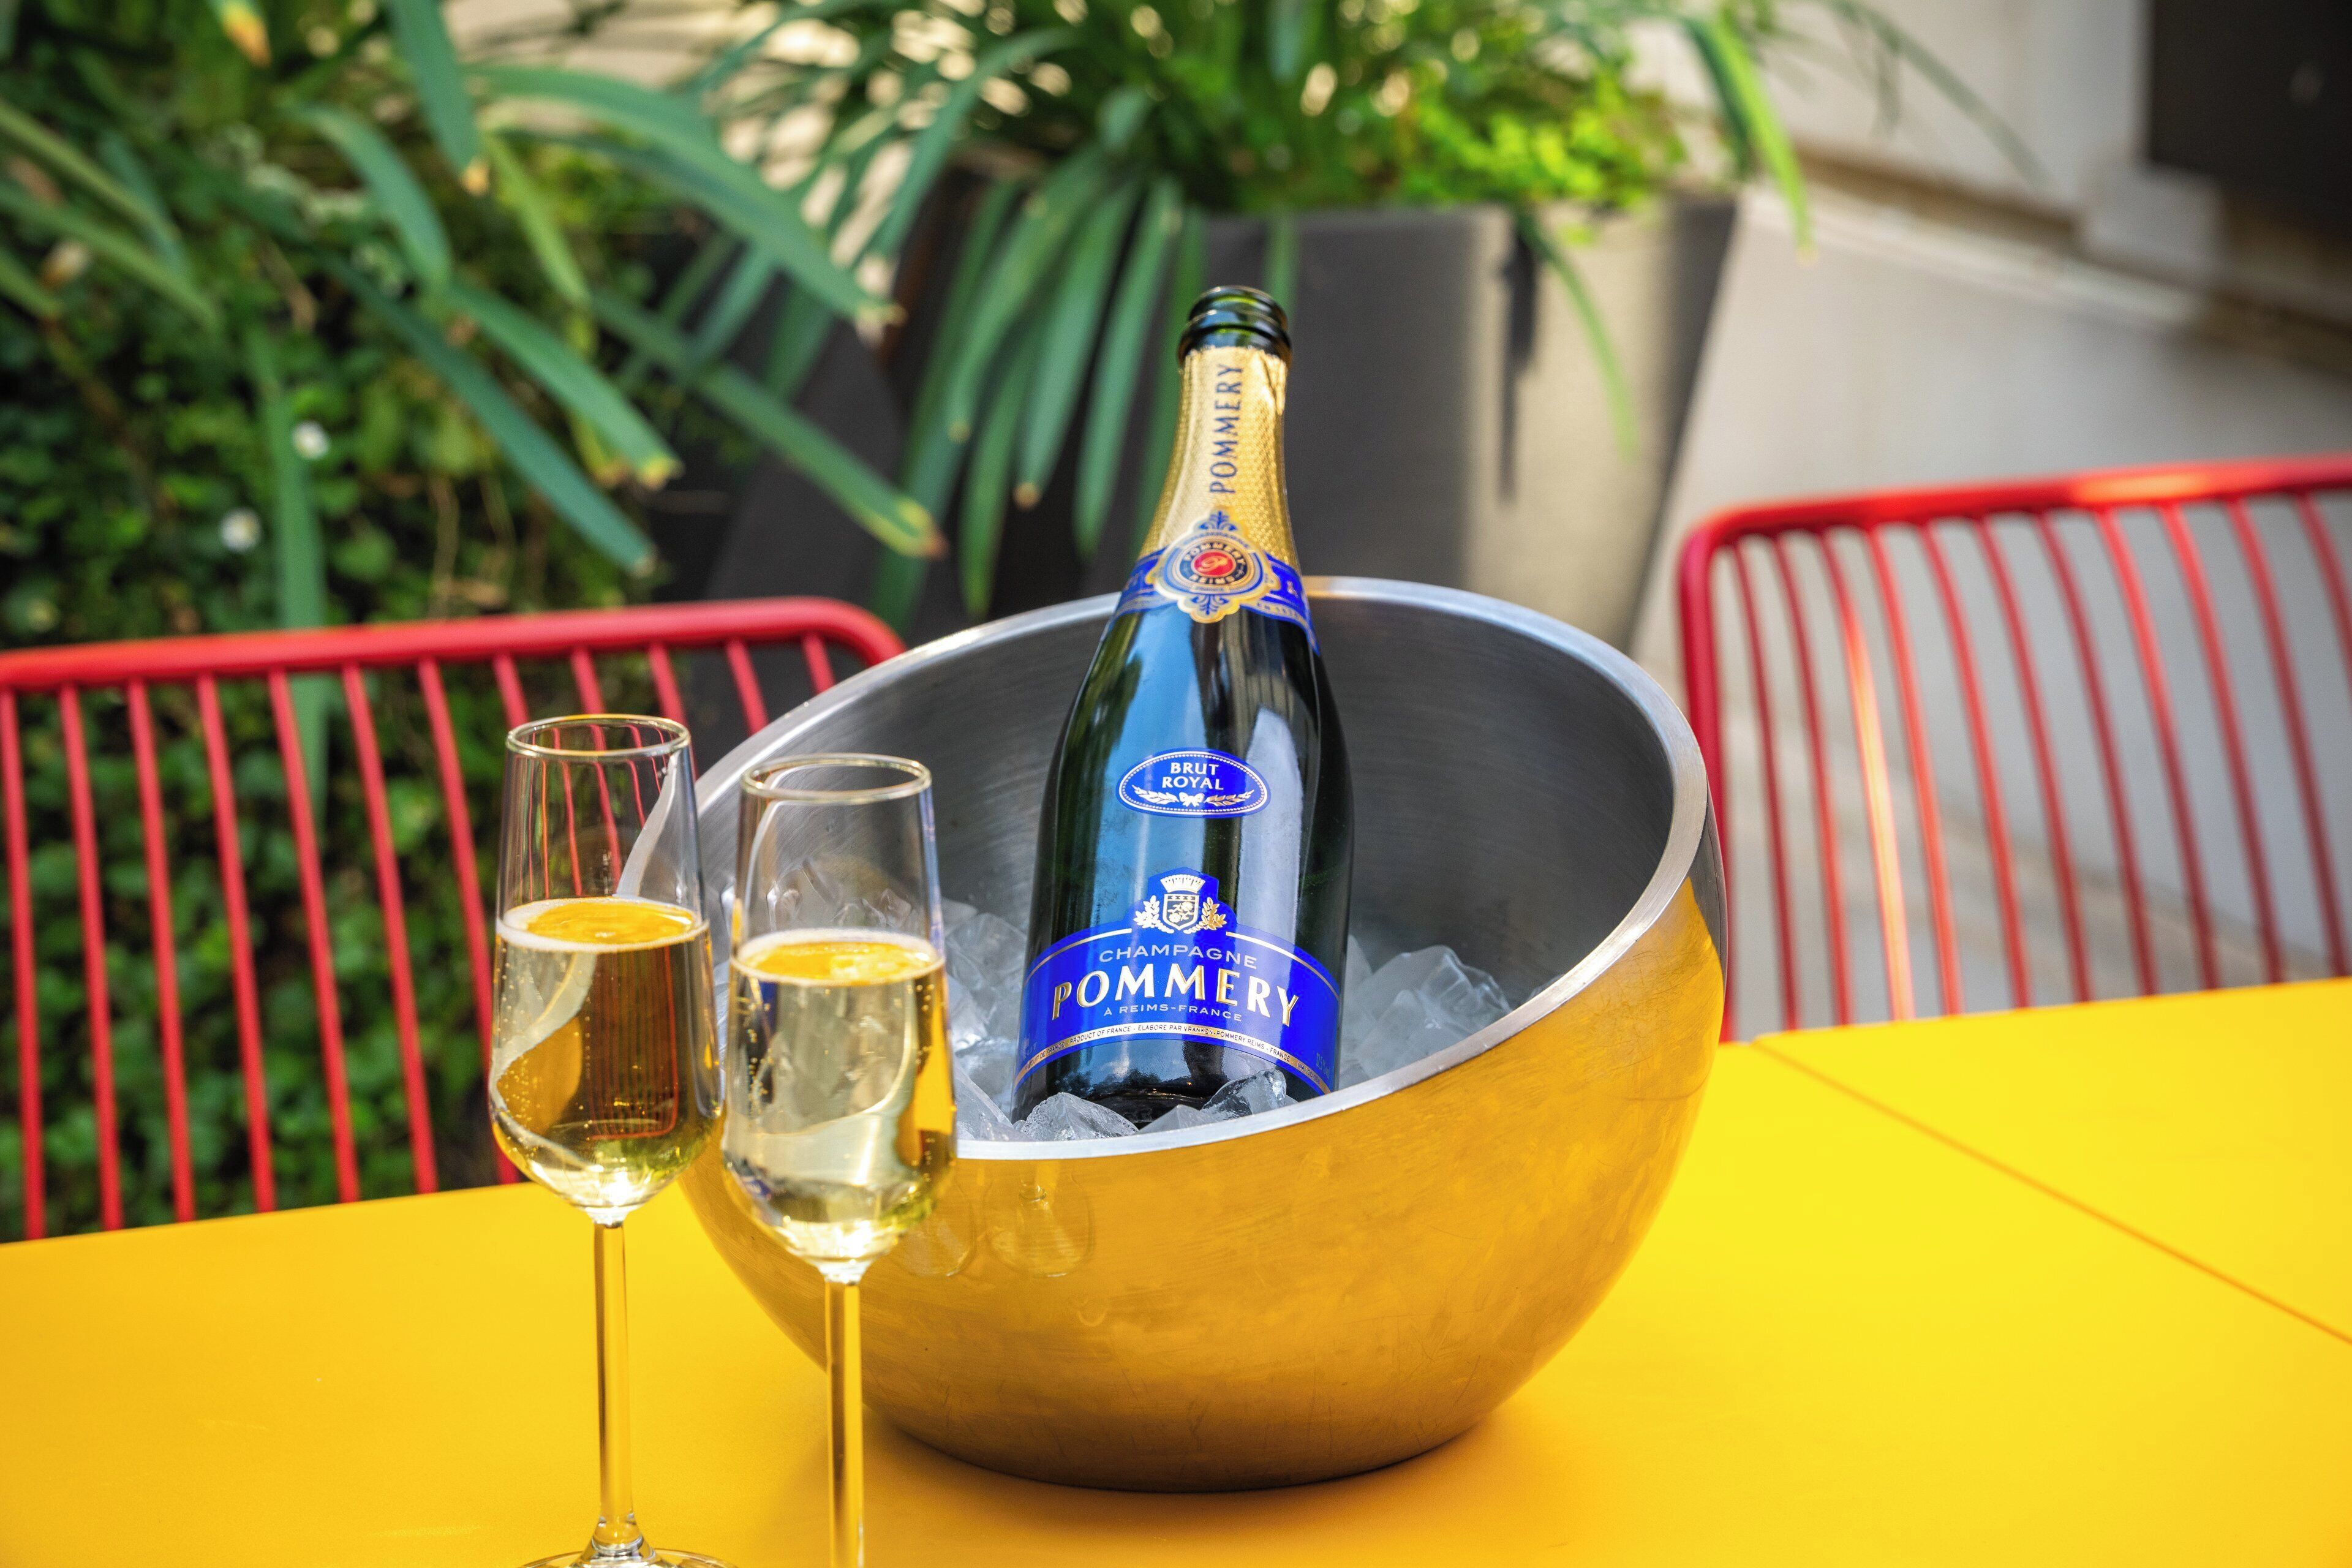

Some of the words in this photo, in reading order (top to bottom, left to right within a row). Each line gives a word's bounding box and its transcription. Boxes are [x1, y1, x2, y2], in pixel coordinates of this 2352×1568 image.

[1209, 363, 1243, 494] POMMERY
[1170, 762, 1219, 775] BRUT
[1162, 776, 1224, 790] ROYAL
[1099, 944, 1257, 970] CHAMPAGNE
[1052, 963, 1299, 1027] POMMERY
[1119, 1003, 1242, 1022] REIMS-FRANCE
[1069, 1031, 1096, 1044] PRODUCT
[1107, 1025, 1131, 1035] FRANCE
[1247, 1039, 1265, 1050] REIMS
[1269, 1047, 1291, 1063] FRANCE
